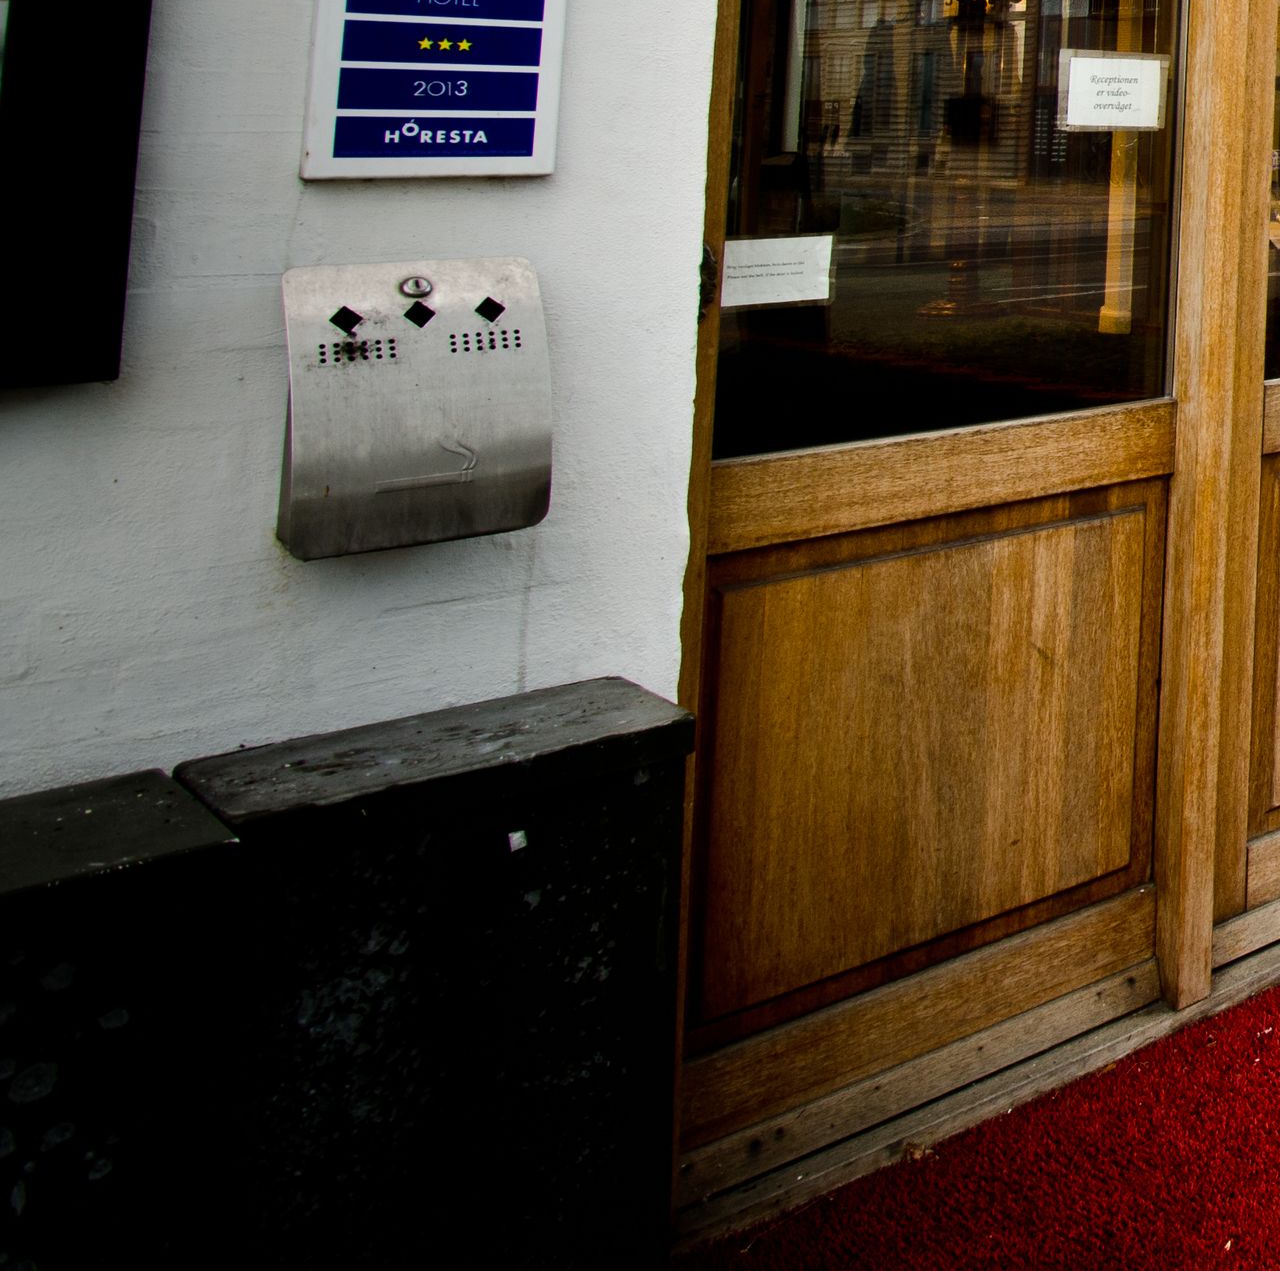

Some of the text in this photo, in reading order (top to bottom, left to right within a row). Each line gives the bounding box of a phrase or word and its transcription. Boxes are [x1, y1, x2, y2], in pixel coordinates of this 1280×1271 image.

[1090, 74, 1139, 87] Receptionen
[413, 80, 469, 97] 2013
[1096, 89, 1104, 97] er
